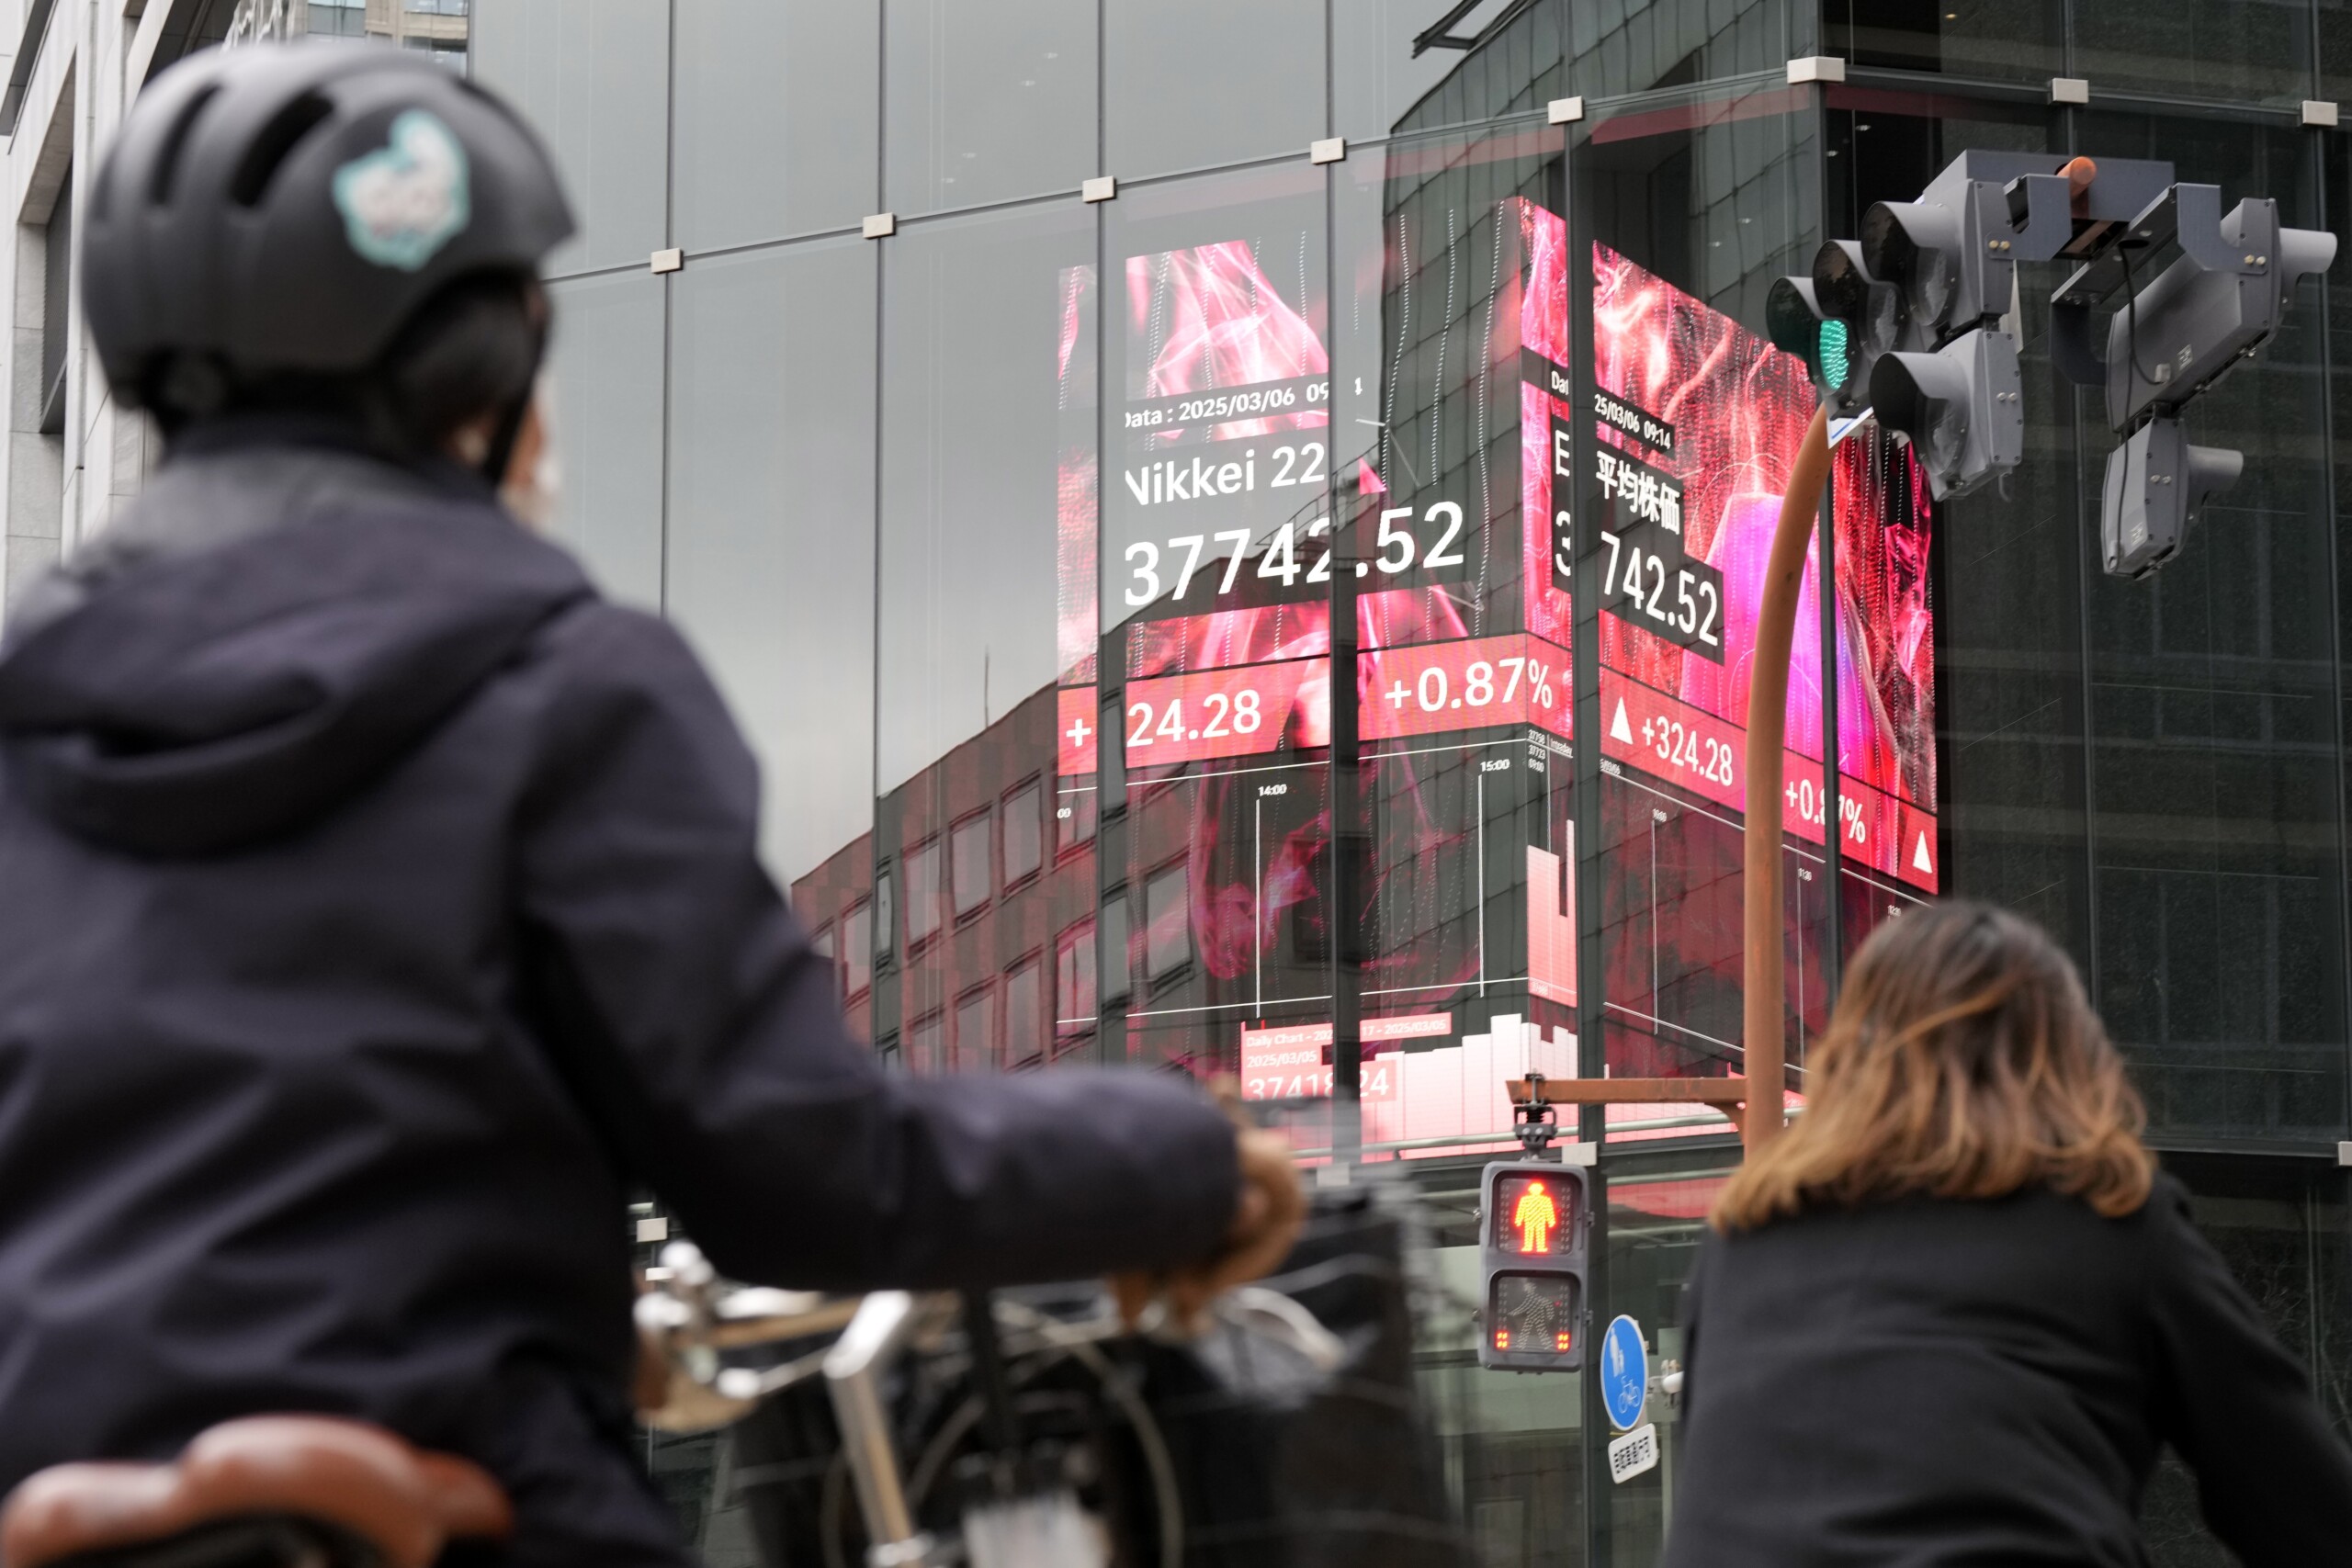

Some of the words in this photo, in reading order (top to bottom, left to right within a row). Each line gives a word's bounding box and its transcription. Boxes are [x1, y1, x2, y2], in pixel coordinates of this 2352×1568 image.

[1179, 388, 1295, 422] 2025/03/06
[1594, 393, 1640, 434] 25/03/06
[1644, 421, 1671, 450] 09:14
[1125, 448, 1255, 506] Nikkei
[1271, 442, 1325, 488] 22
[1125, 501, 1464, 606] 37742.52
[1385, 657, 1553, 712] +0.87%
[1480, 759, 1510, 772] 15:00
[1642, 716, 1733, 786] +324.28
[1258, 784, 1287, 796] 14:00
[1247, 1035, 1272, 1048] Daily
[1274, 1032, 1304, 1044] Chart
[1385, 1020, 1446, 1035] 2025/03/05
[1247, 1050, 1317, 1067] 2025/03/05
